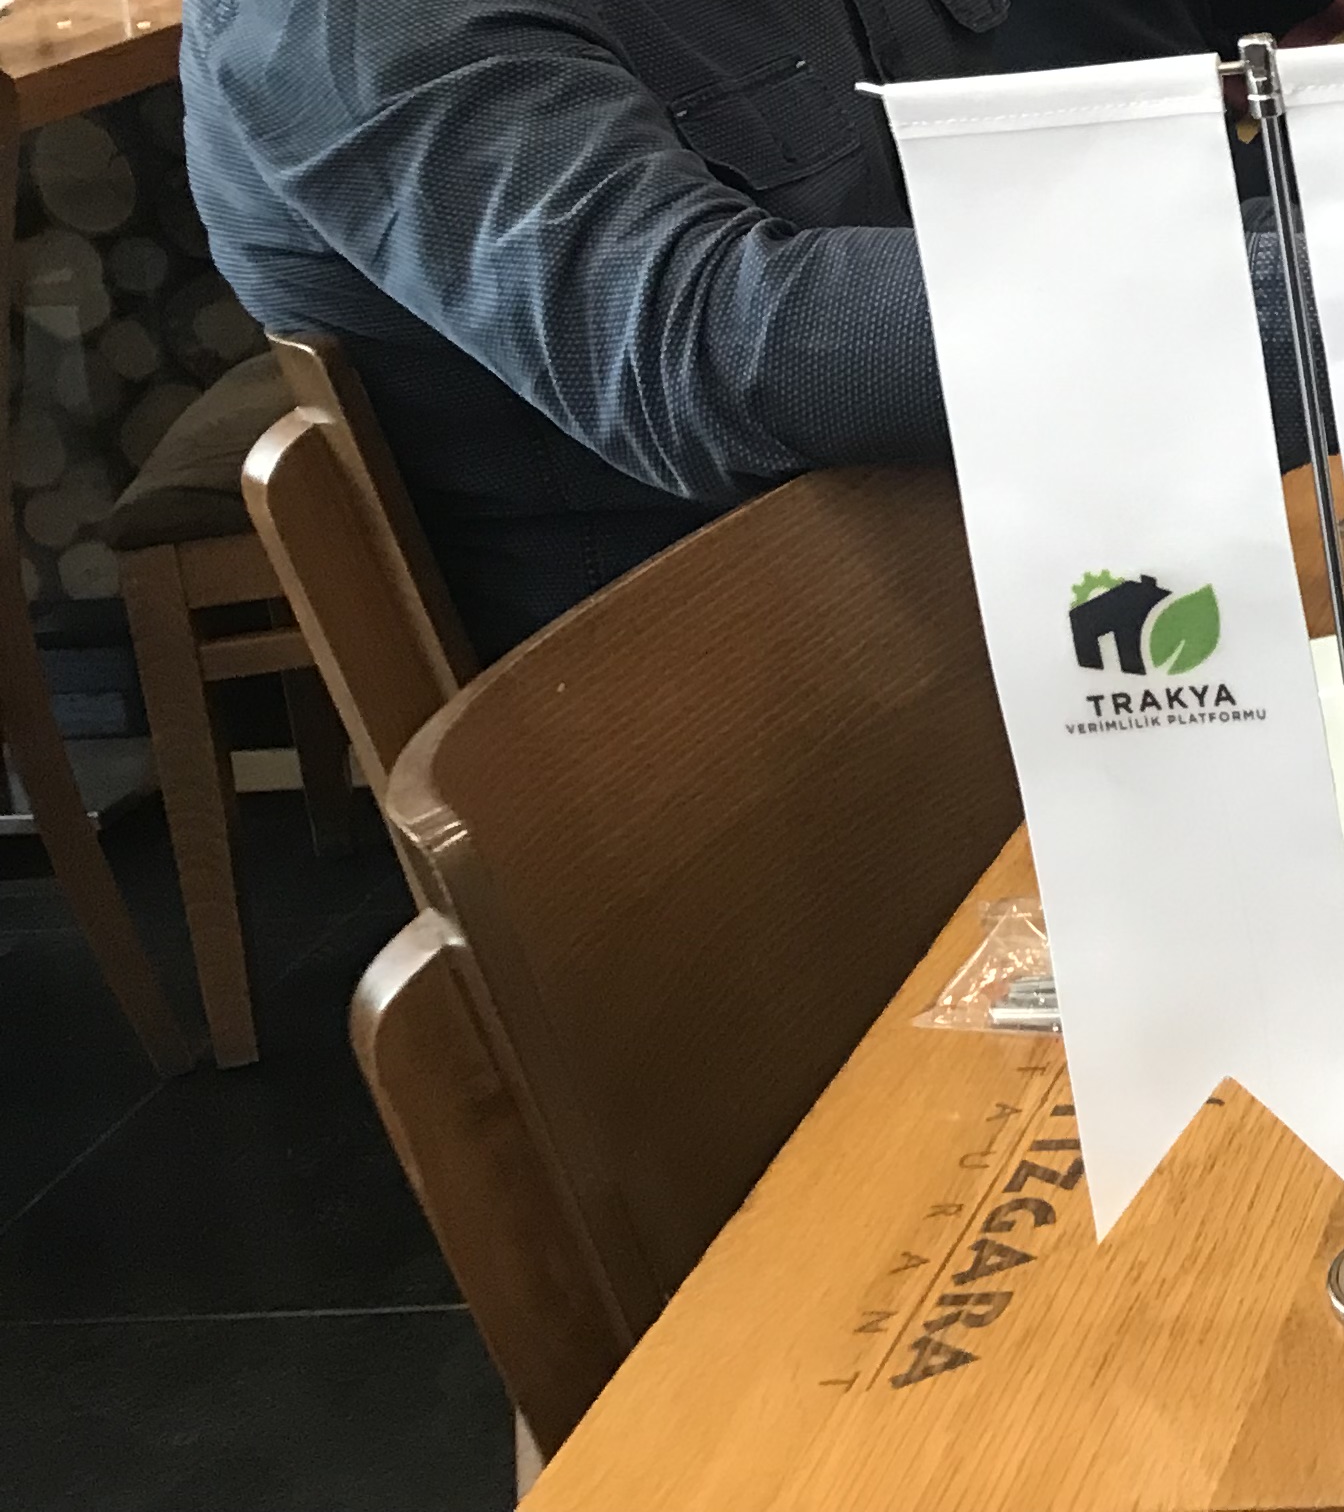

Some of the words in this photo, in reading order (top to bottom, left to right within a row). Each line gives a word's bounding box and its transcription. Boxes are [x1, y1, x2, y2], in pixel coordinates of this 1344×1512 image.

[1086, 683, 1237, 717] TRAKYA
[1066, 713, 1161, 736] VERİMLİLİK
[1167, 708, 1268, 726] PLATFORMU
[818, 1061, 1051, 1393] TAURANT
